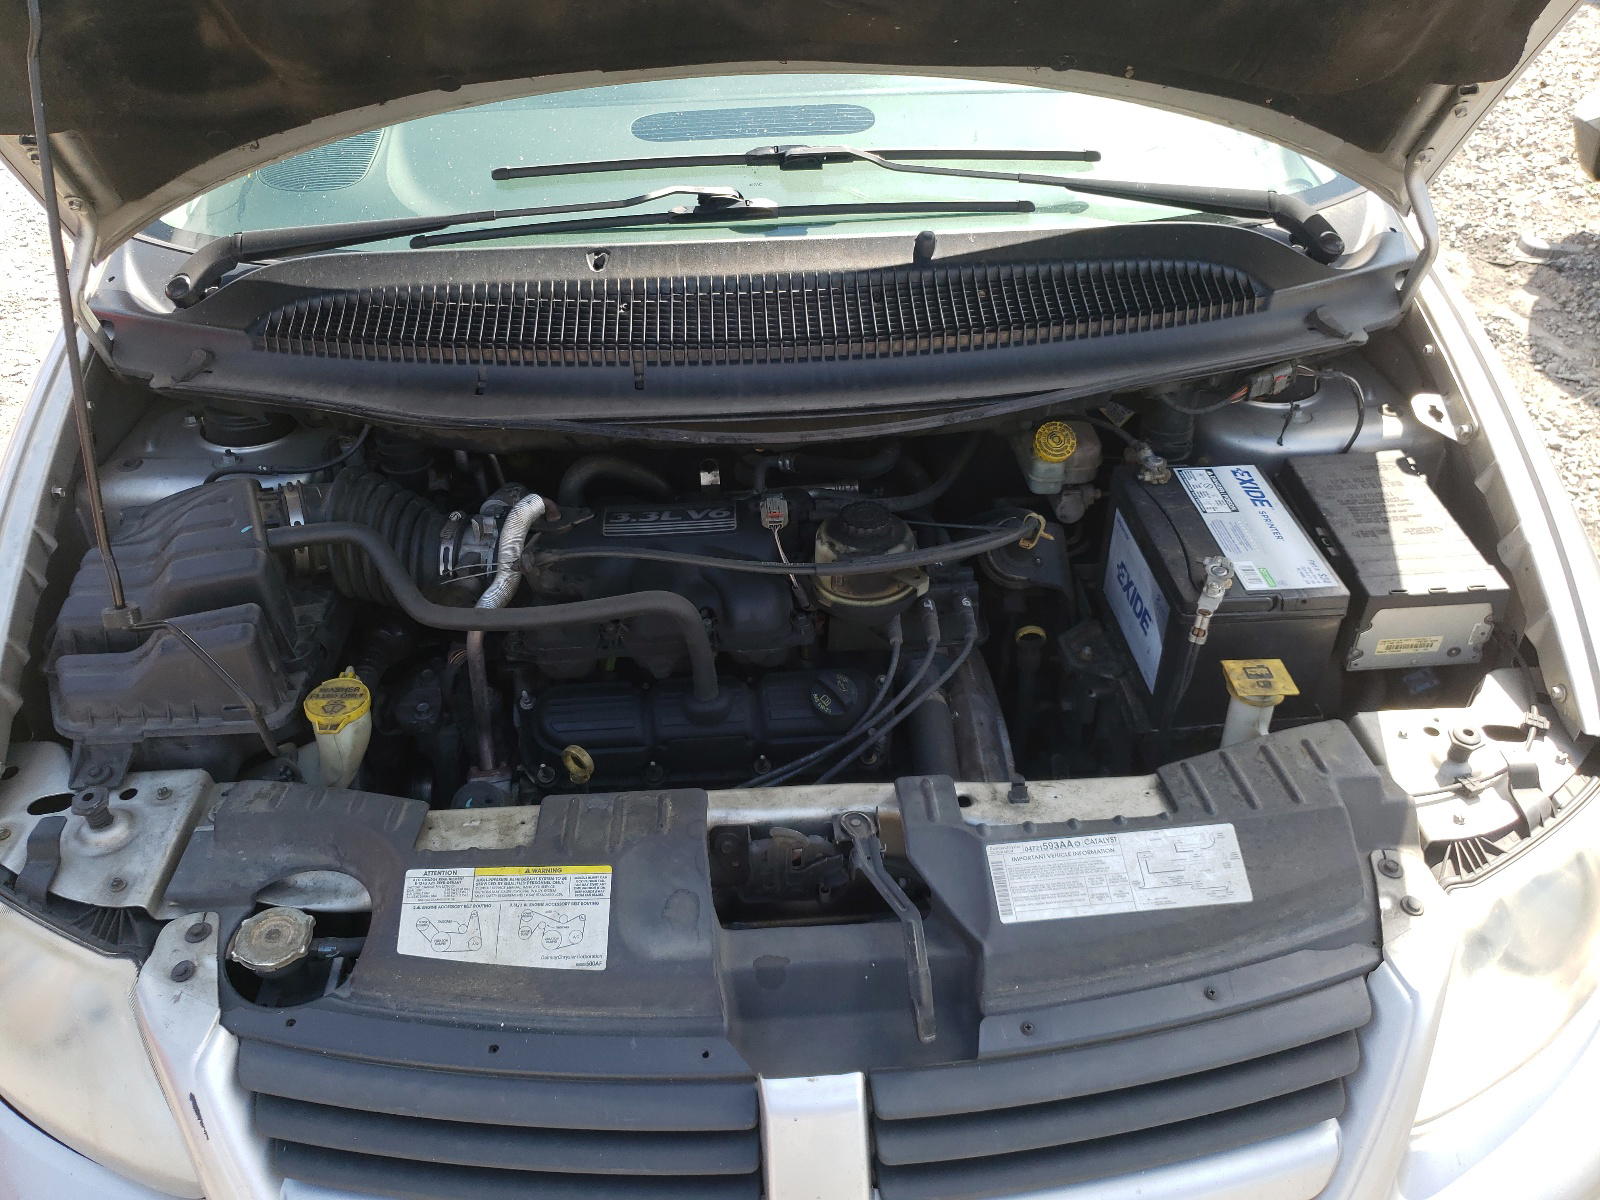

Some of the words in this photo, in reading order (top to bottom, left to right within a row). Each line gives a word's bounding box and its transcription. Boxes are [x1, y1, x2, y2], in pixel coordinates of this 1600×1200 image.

[1230, 467, 1273, 508] EXIDE
[609, 510, 682, 523] 3.3L
[687, 508, 731, 520] V6
[1259, 511, 1284, 541] SPRINTER
[1117, 560, 1152, 636] EXIDE
[1084, 836, 1118, 846] CATALYST
[1011, 854, 1046, 862] IMPORTANT
[1046, 851, 1071, 859] VEHICLE
[1073, 847, 1115, 857] INFORMATION
